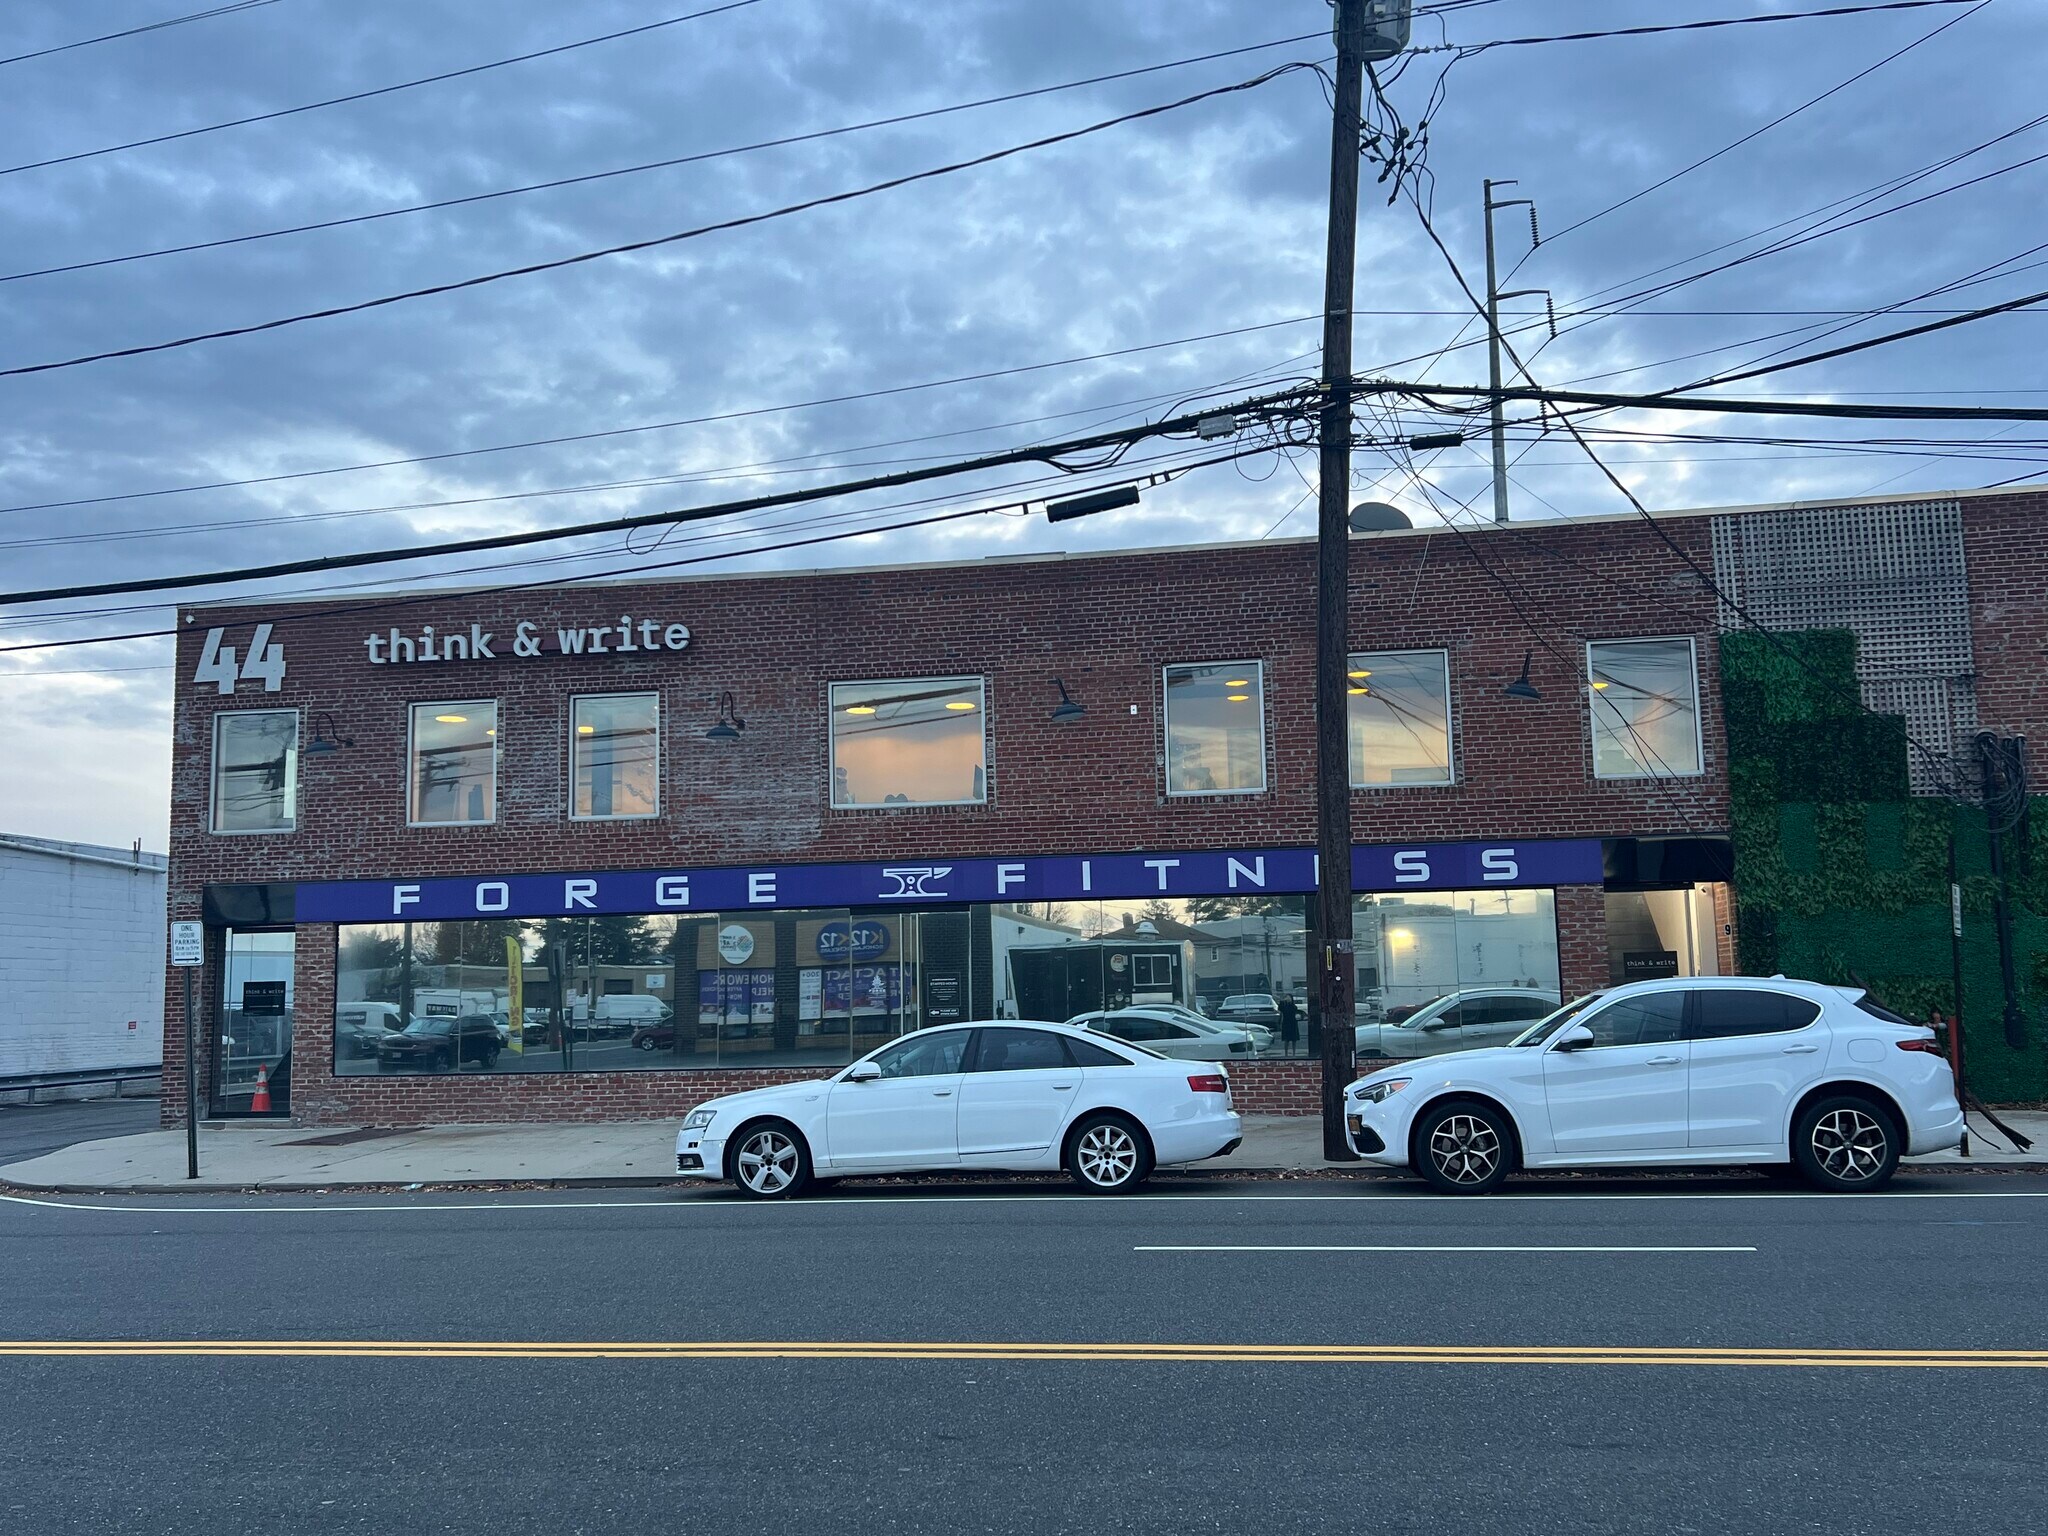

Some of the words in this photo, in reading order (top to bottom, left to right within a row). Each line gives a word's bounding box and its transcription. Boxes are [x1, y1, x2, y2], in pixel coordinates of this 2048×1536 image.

[193, 624, 286, 694] 44
[364, 624, 496, 664] think
[512, 621, 542, 657] &
[557, 615, 690, 655] write
[393, 872, 776, 914] FORGE
[997, 848, 1518, 894] FITNSS
[1724, 924, 1731, 935] 9
